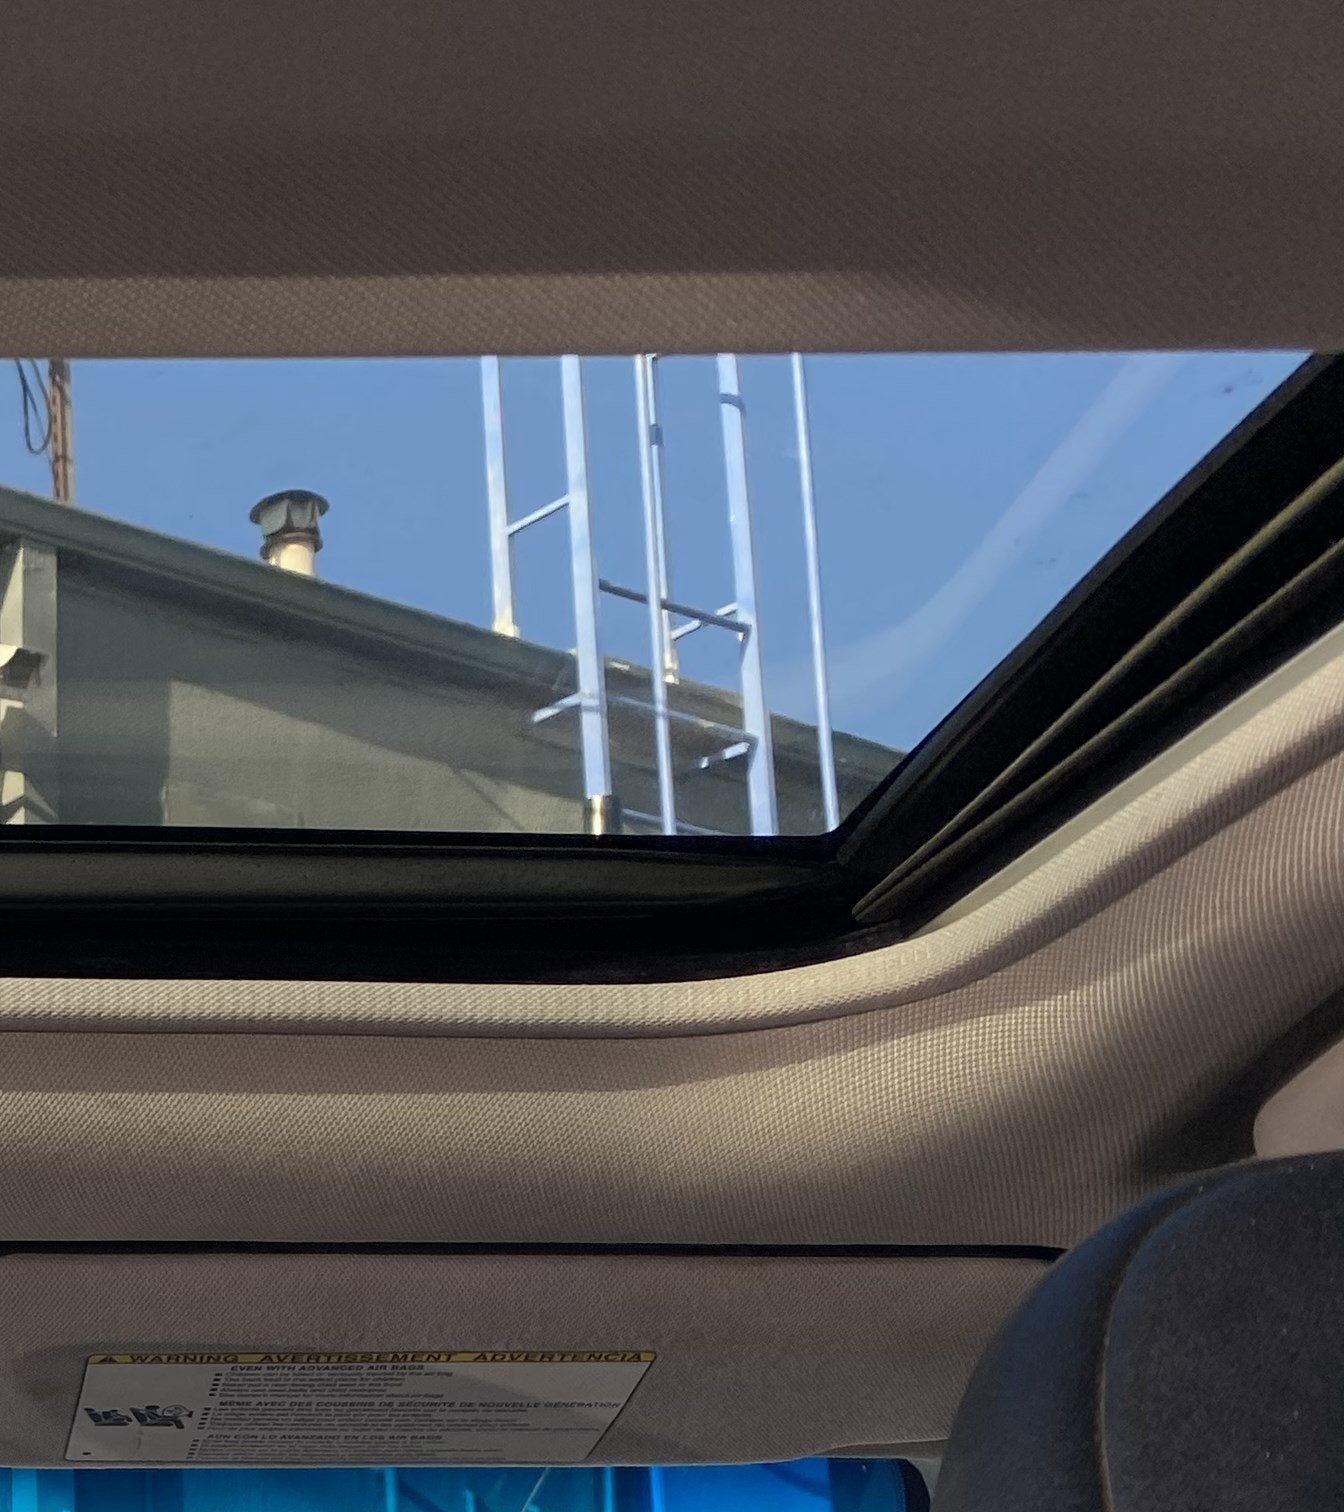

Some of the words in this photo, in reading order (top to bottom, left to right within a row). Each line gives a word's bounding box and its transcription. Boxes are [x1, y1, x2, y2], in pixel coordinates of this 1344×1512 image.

[129, 1354, 239, 1364] WARNING
[260, 1353, 458, 1363] AVERTISSEMENT
[471, 1352, 643, 1362] ADVERTENCIA
